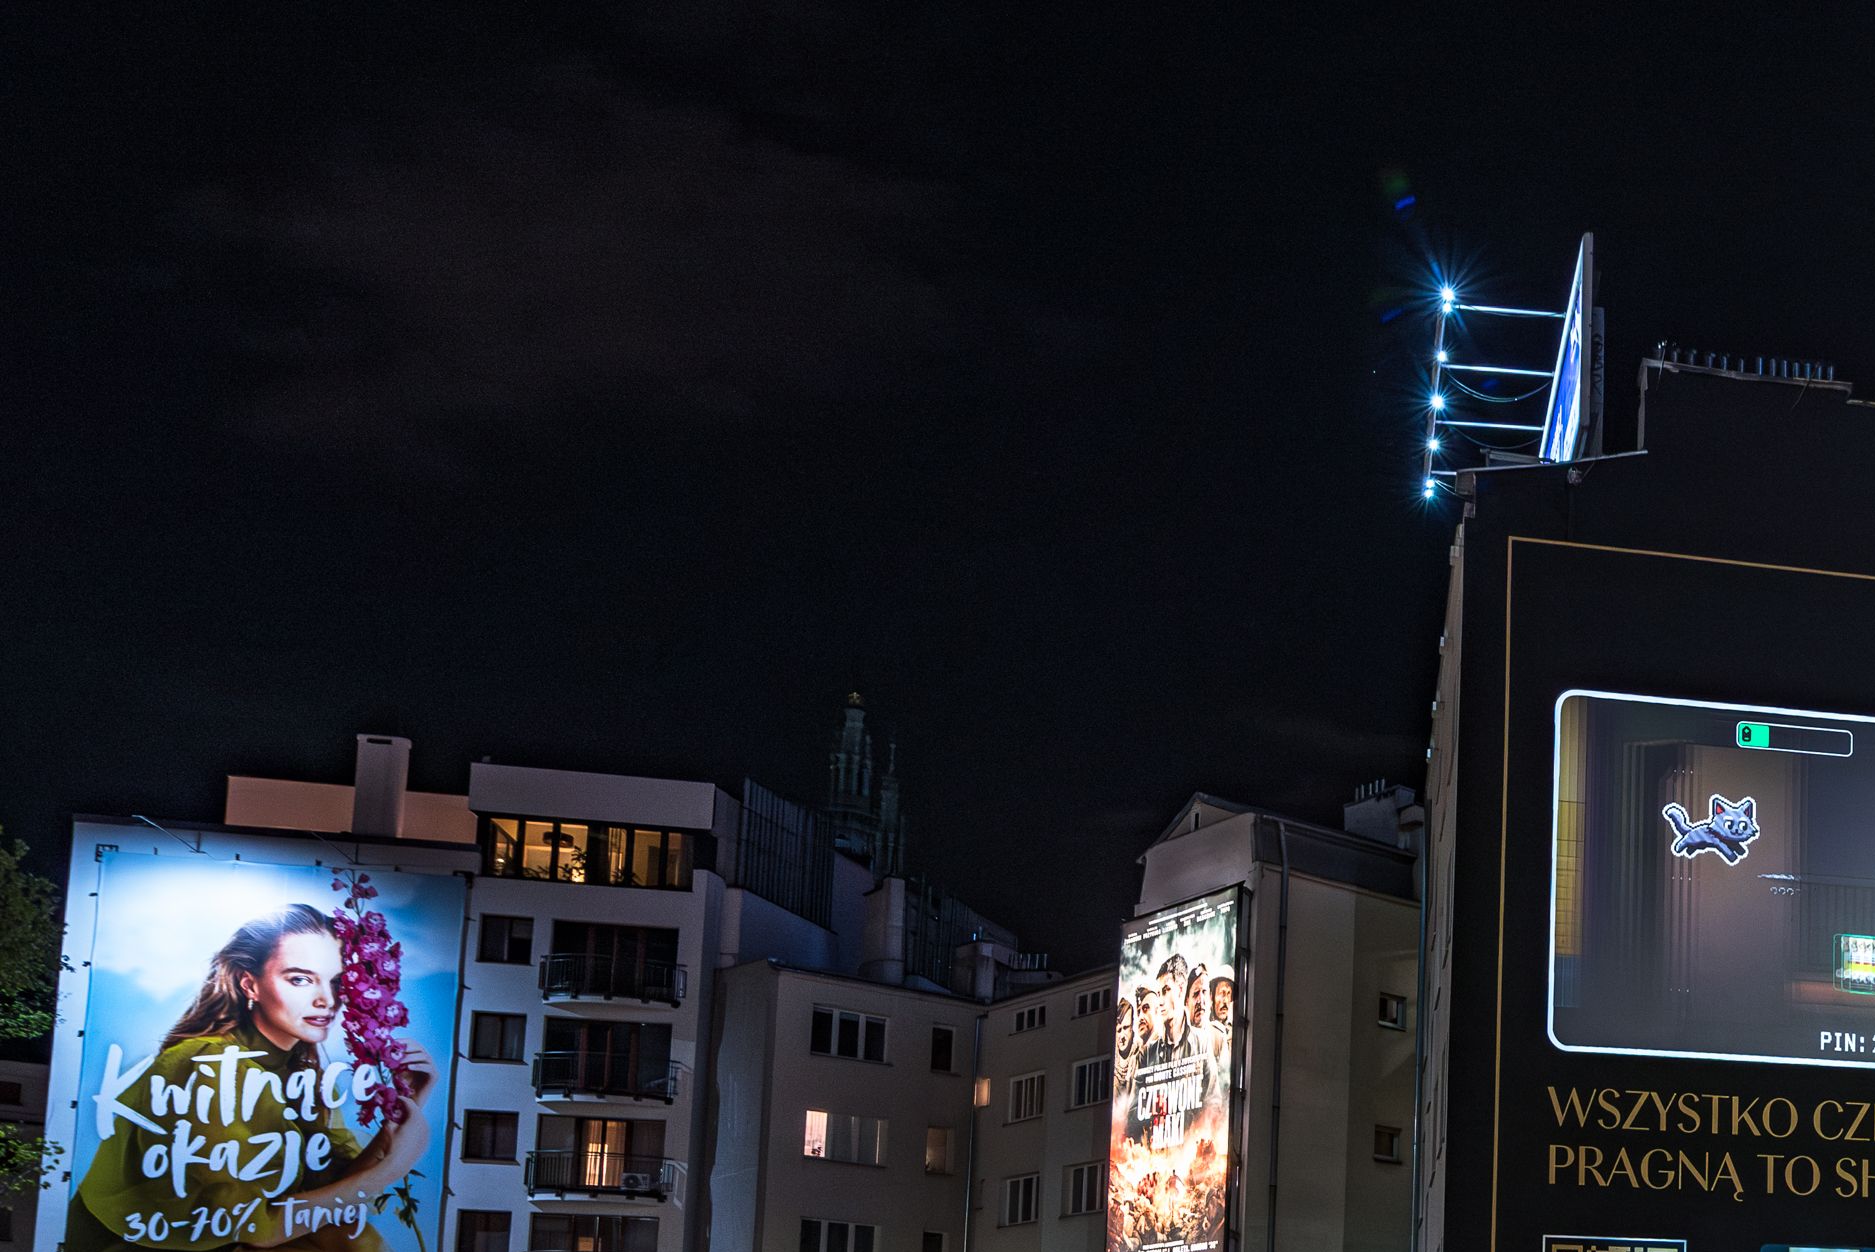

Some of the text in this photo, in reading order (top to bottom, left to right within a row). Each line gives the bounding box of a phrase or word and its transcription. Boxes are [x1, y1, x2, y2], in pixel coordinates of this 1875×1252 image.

[1820, 1031, 1865, 1053] PIN:
[92, 1043, 378, 1140] Kwitnące
[1137, 1074, 1204, 1121] CZERWONE
[1547, 1085, 1799, 1138] WSZYSTKO
[142, 1119, 332, 1199] okazje
[1548, 1144, 1745, 1202] PRAGNĄ
[1757, 1153, 1822, 1197] TO
[123, 1197, 261, 1242] 30-70%
